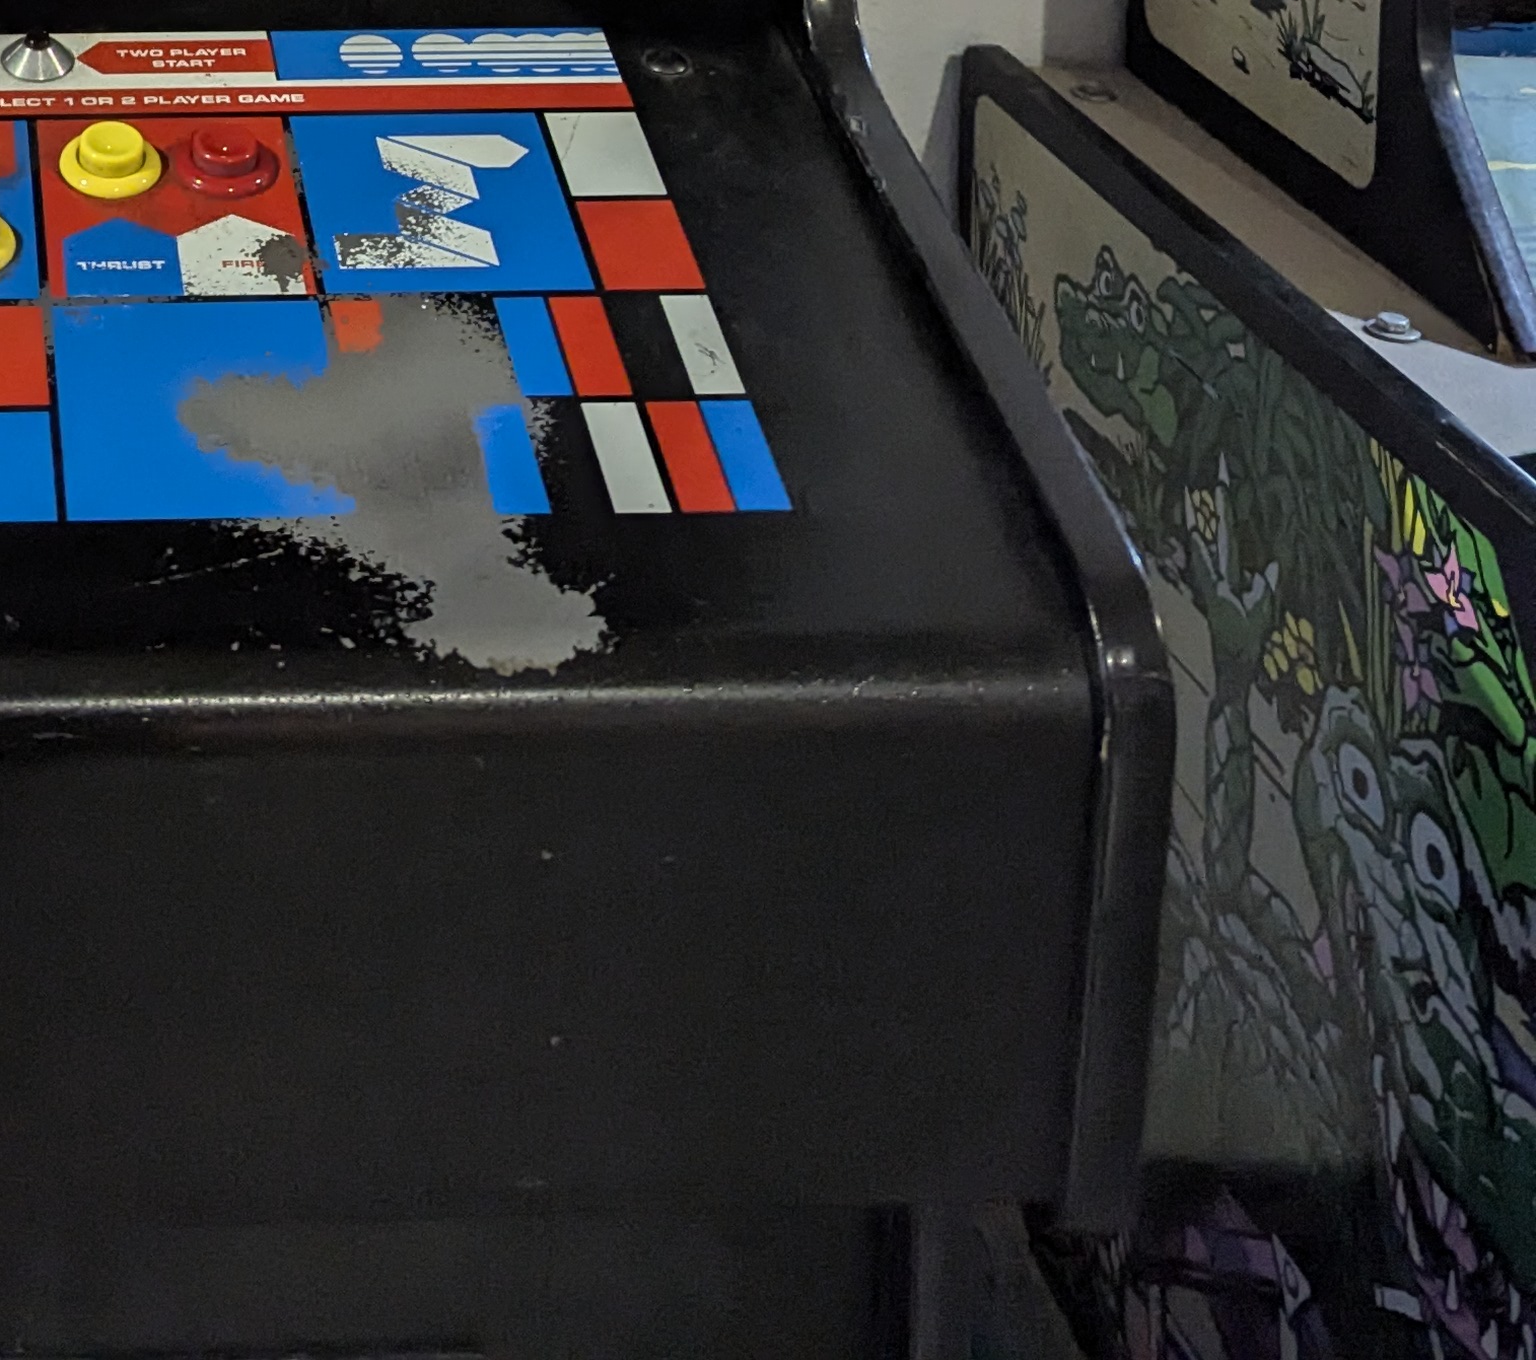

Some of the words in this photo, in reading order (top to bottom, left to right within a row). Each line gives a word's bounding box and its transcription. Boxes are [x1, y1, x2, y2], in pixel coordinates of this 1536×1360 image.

[116, 48, 164, 58] TWO
[170, 47, 247, 57] PLAYER
[152, 58, 216, 68] START
[64, 96, 74, 107] 1
[81, 96, 114, 107] OR
[121, 95, 137, 106] 2
[143, 94, 234, 106] PLAYER
[238, 93, 305, 104] GAME
[76, 259, 166, 271] THRUST
